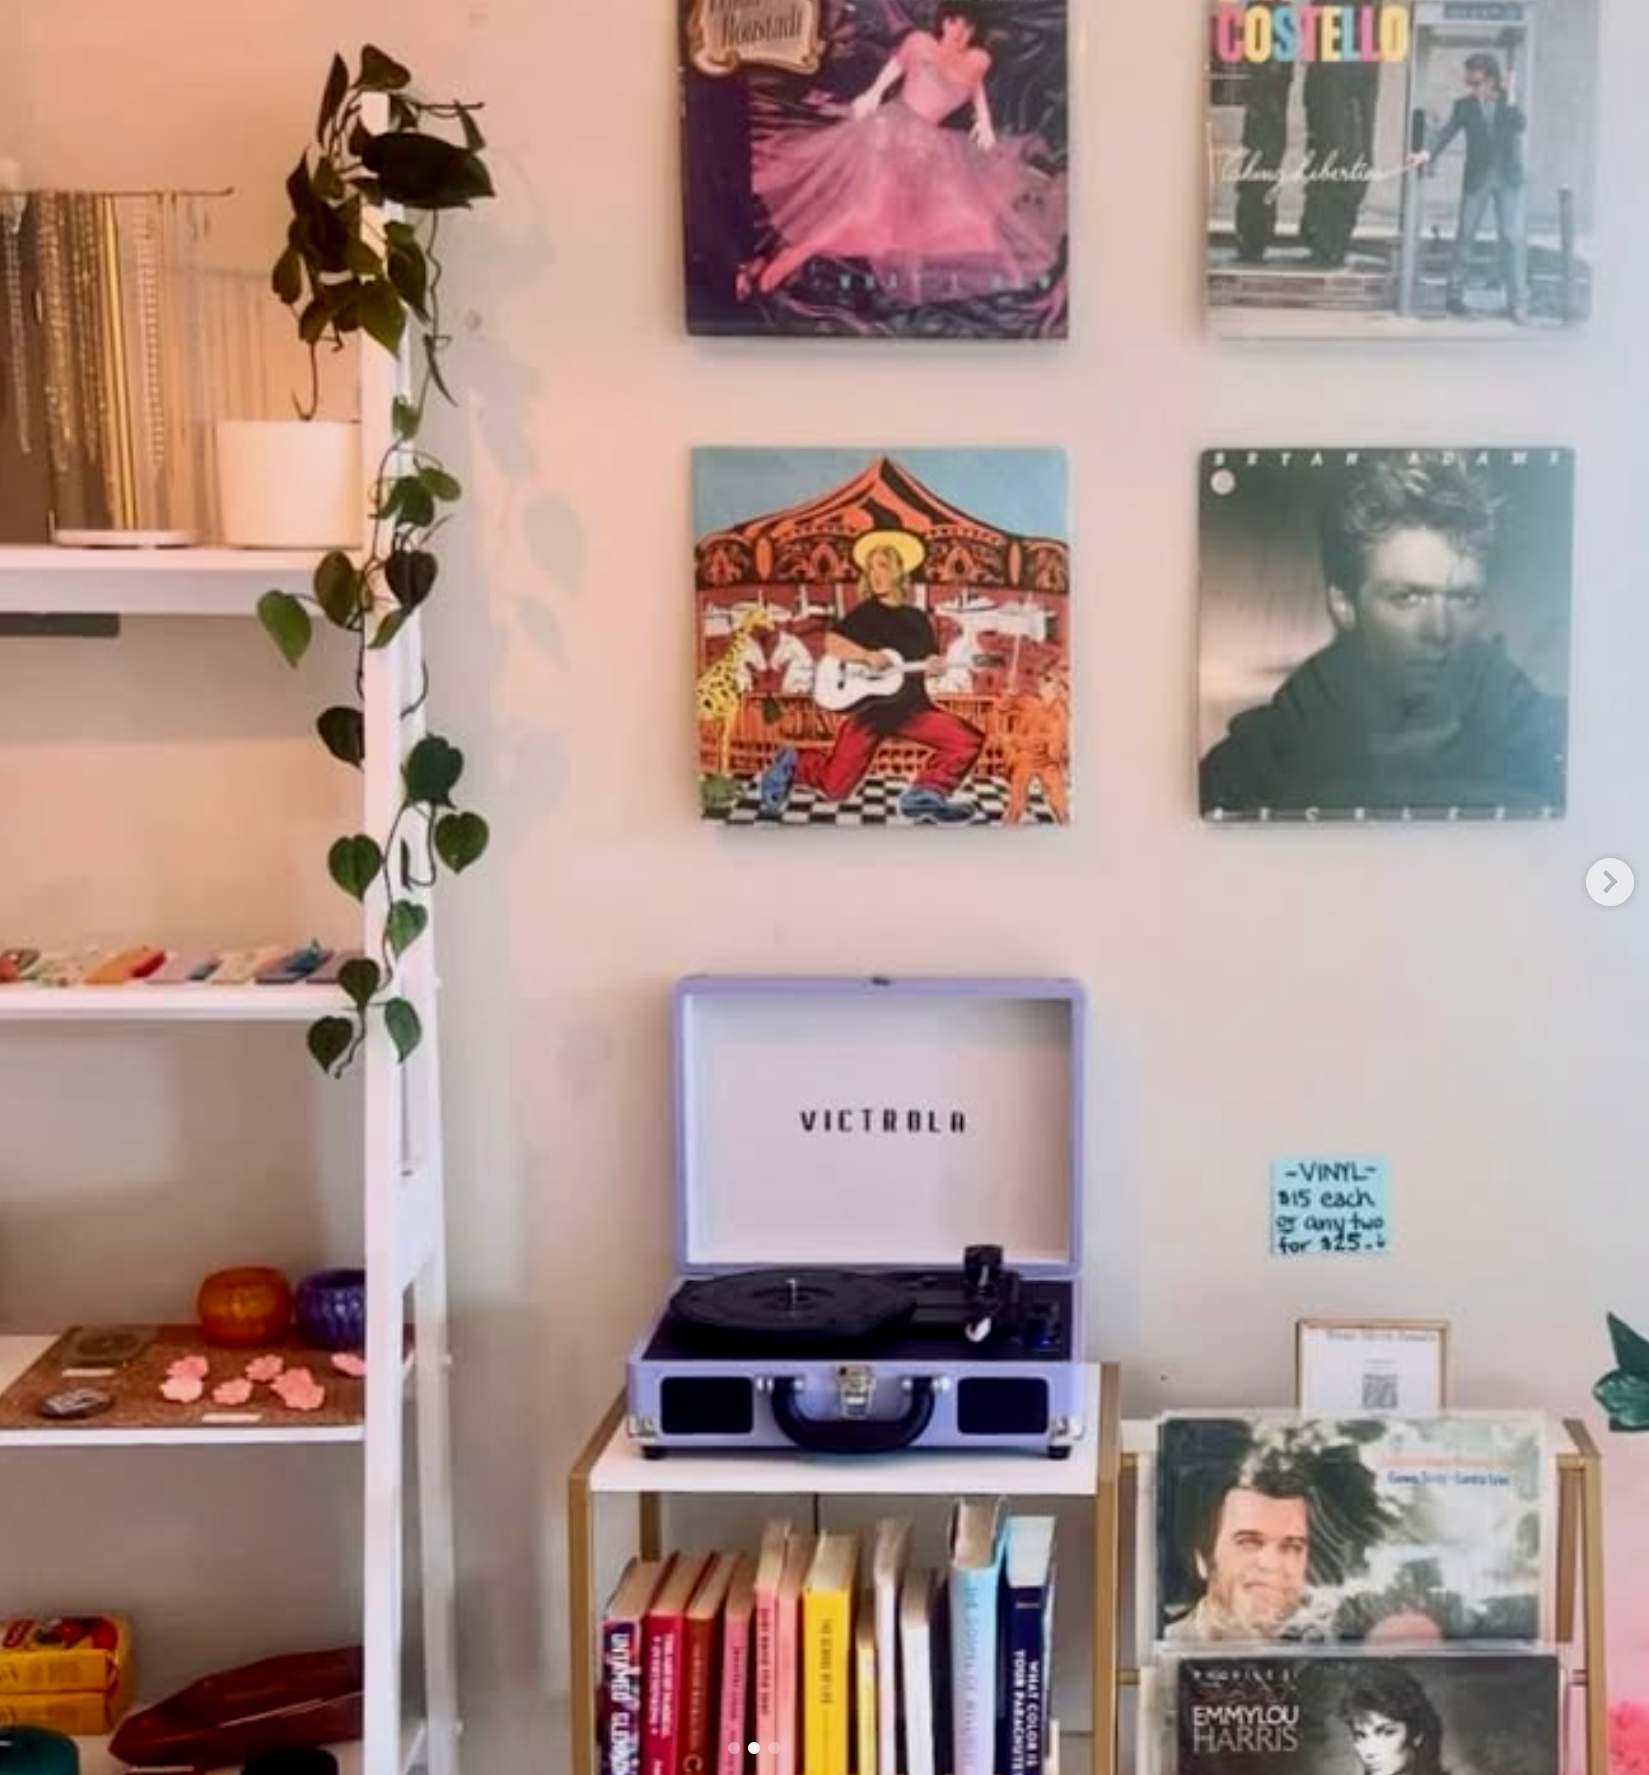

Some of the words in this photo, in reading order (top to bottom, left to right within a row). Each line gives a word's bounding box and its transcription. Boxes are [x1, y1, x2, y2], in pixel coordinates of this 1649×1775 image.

[1217, 4, 1410, 63] COSTELLO
[800, 1108, 966, 1133] VICTROLA
[1277, 1188, 1312, 1207] $15
[1320, 1187, 1376, 1208] each
[1276, 1215, 1298, 1235] or
[1303, 1215, 1346, 1242] any
[1349, 1211, 1385, 1231] two
[1278, 1235, 1312, 1255] for
[1014, 1650, 1027, 1688] YOUR
[1027, 1661, 1040, 1698] WHAT
[1026, 1704, 1039, 1750] COLOR
[1193, 1704, 1299, 1727] EMMYLOU
[1193, 1725, 1299, 1754] HARRIS
[1026, 1755, 1039, 1767] IS
